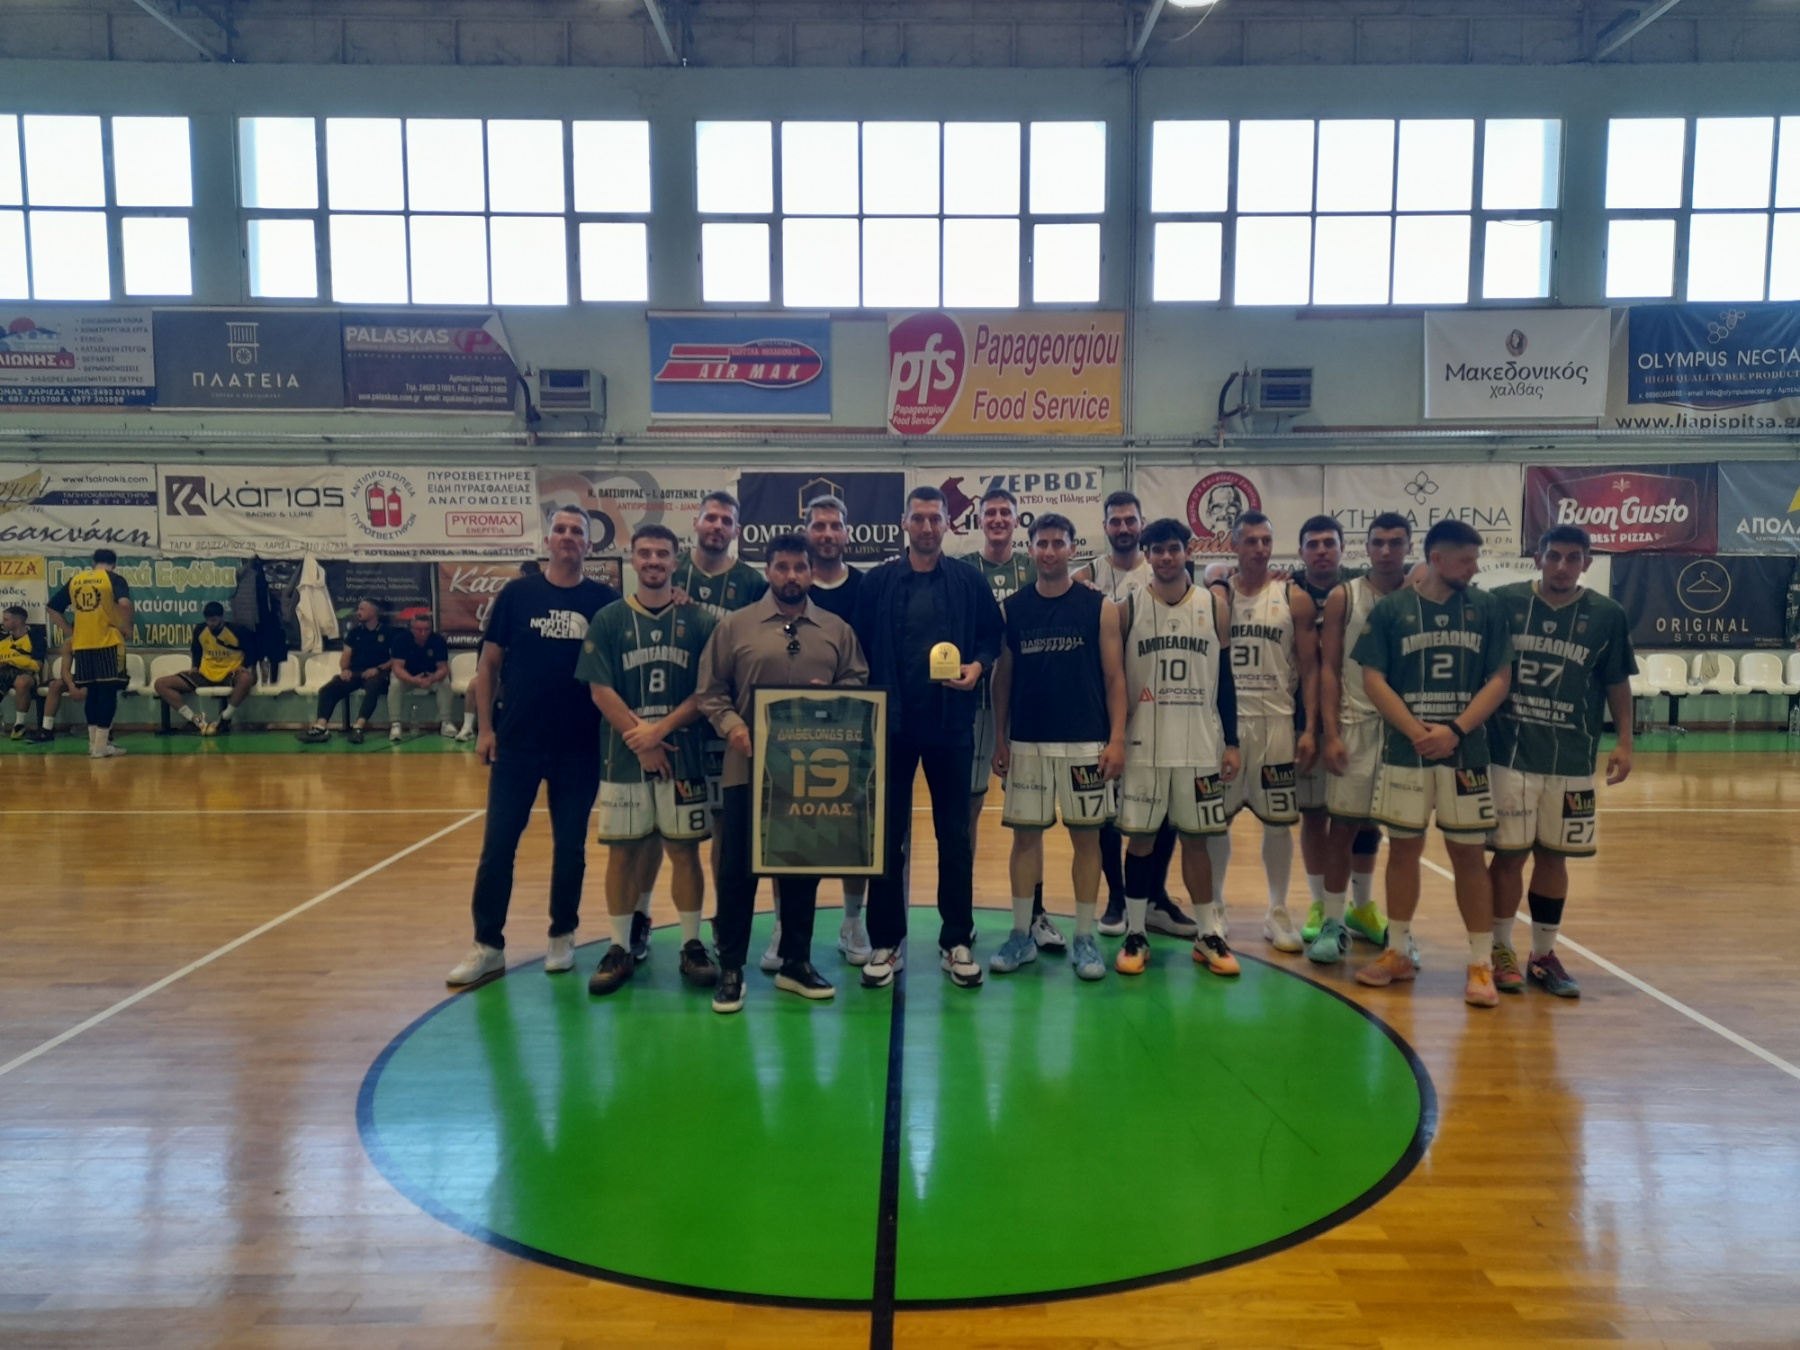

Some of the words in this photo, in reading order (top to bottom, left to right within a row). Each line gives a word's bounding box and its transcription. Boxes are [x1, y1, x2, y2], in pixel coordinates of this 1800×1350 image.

[346, 327, 449, 344] PALASKAS
[973, 322, 1120, 376] Papageorgiou
[1638, 351, 1728, 370] OLYMPUS
[192, 372, 299, 388] ΠΛΑΤΕΙΑ
[699, 364, 738, 378] AIR
[751, 364, 800, 379] MAX
[889, 333, 956, 418] pfs
[1445, 361, 1589, 385] Μακεδονικός
[1644, 375, 1674, 384] HIGH
[1677, 373, 1722, 383] QUALITY
[1725, 372, 1746, 381] BEE
[1489, 382, 1544, 399] χαλβάς
[895, 404, 945, 414] Papageorgiou
[972, 389, 1027, 422] Food
[1032, 388, 1111, 422] Service
[893, 416, 909, 425] Food
[911, 416, 937, 425] Service
[62, 475, 148, 483] www.tsaknakis.com
[350, 470, 416, 499] ΑΝΤΙΠΡΟΣΩΠΕΙΑ
[428, 471, 531, 481] ΠΥΡΟΣΒΕΣΤΗΡΕΣ
[980, 472, 1097, 493] ΖΕΡΒΟΣ
[428, 484, 451, 493] ΕΙΔΗ
[453, 483, 531, 493] ΠΥΡΑΣΦΑΛΕΙΑΣ
[428, 496, 532, 505] ΑΝΑΓΟΜΩΣΕΙΣ
[1019, 495, 1043, 504] ΚΤΕΟ
[452, 515, 518, 526] PYROMAX
[1331, 508, 1418, 529] ΚΤΗΑ
[1557, 498, 1619, 531] Buon
[1620, 496, 1689, 525] Gusto
[351, 512, 417, 540] ΠΥΡΟΣΒΕΣΤΗΡΩΝ
[1736, 517, 1800, 534] ΑΠΟΛ
[264, 541, 291, 550] ΛΑΡΙΣΑ
[1590, 533, 1617, 544] BEST
[1619, 532, 1653, 543] PIZZA
[155, 560, 238, 593] Εφόδια
[82, 593, 93, 606] 12
[134, 596, 198, 617] καύσιμα
[530, 618, 570, 629] NORTH
[548, 610, 570, 619] THE
[540, 628, 570, 639] FACE
[1231, 624, 1284, 644] ΠΕΛΩΝΑΣ
[1656, 617, 1749, 632] ORIGINAL
[1138, 635, 1210, 657] ΑΜΠΕΛΩΝΑΣ
[1402, 630, 1483, 657] ΑΜΠΕΛΩΝΑΣ
[1674, 633, 1730, 642] STORE
[1233, 645, 1259, 667] 31
[1160, 659, 1187, 682] 10
[1431, 653, 1454, 679] 2
[1519, 659, 1565, 687] 27
[648, 668, 665, 693] 8
[791, 747, 850, 797] 19
[788, 802, 854, 816] ΛΟΛΑΣ
[1078, 795, 1104, 817] 17
[1201, 804, 1226, 826] 10
[689, 809, 706, 831] 8
[1566, 820, 1595, 844] 27
